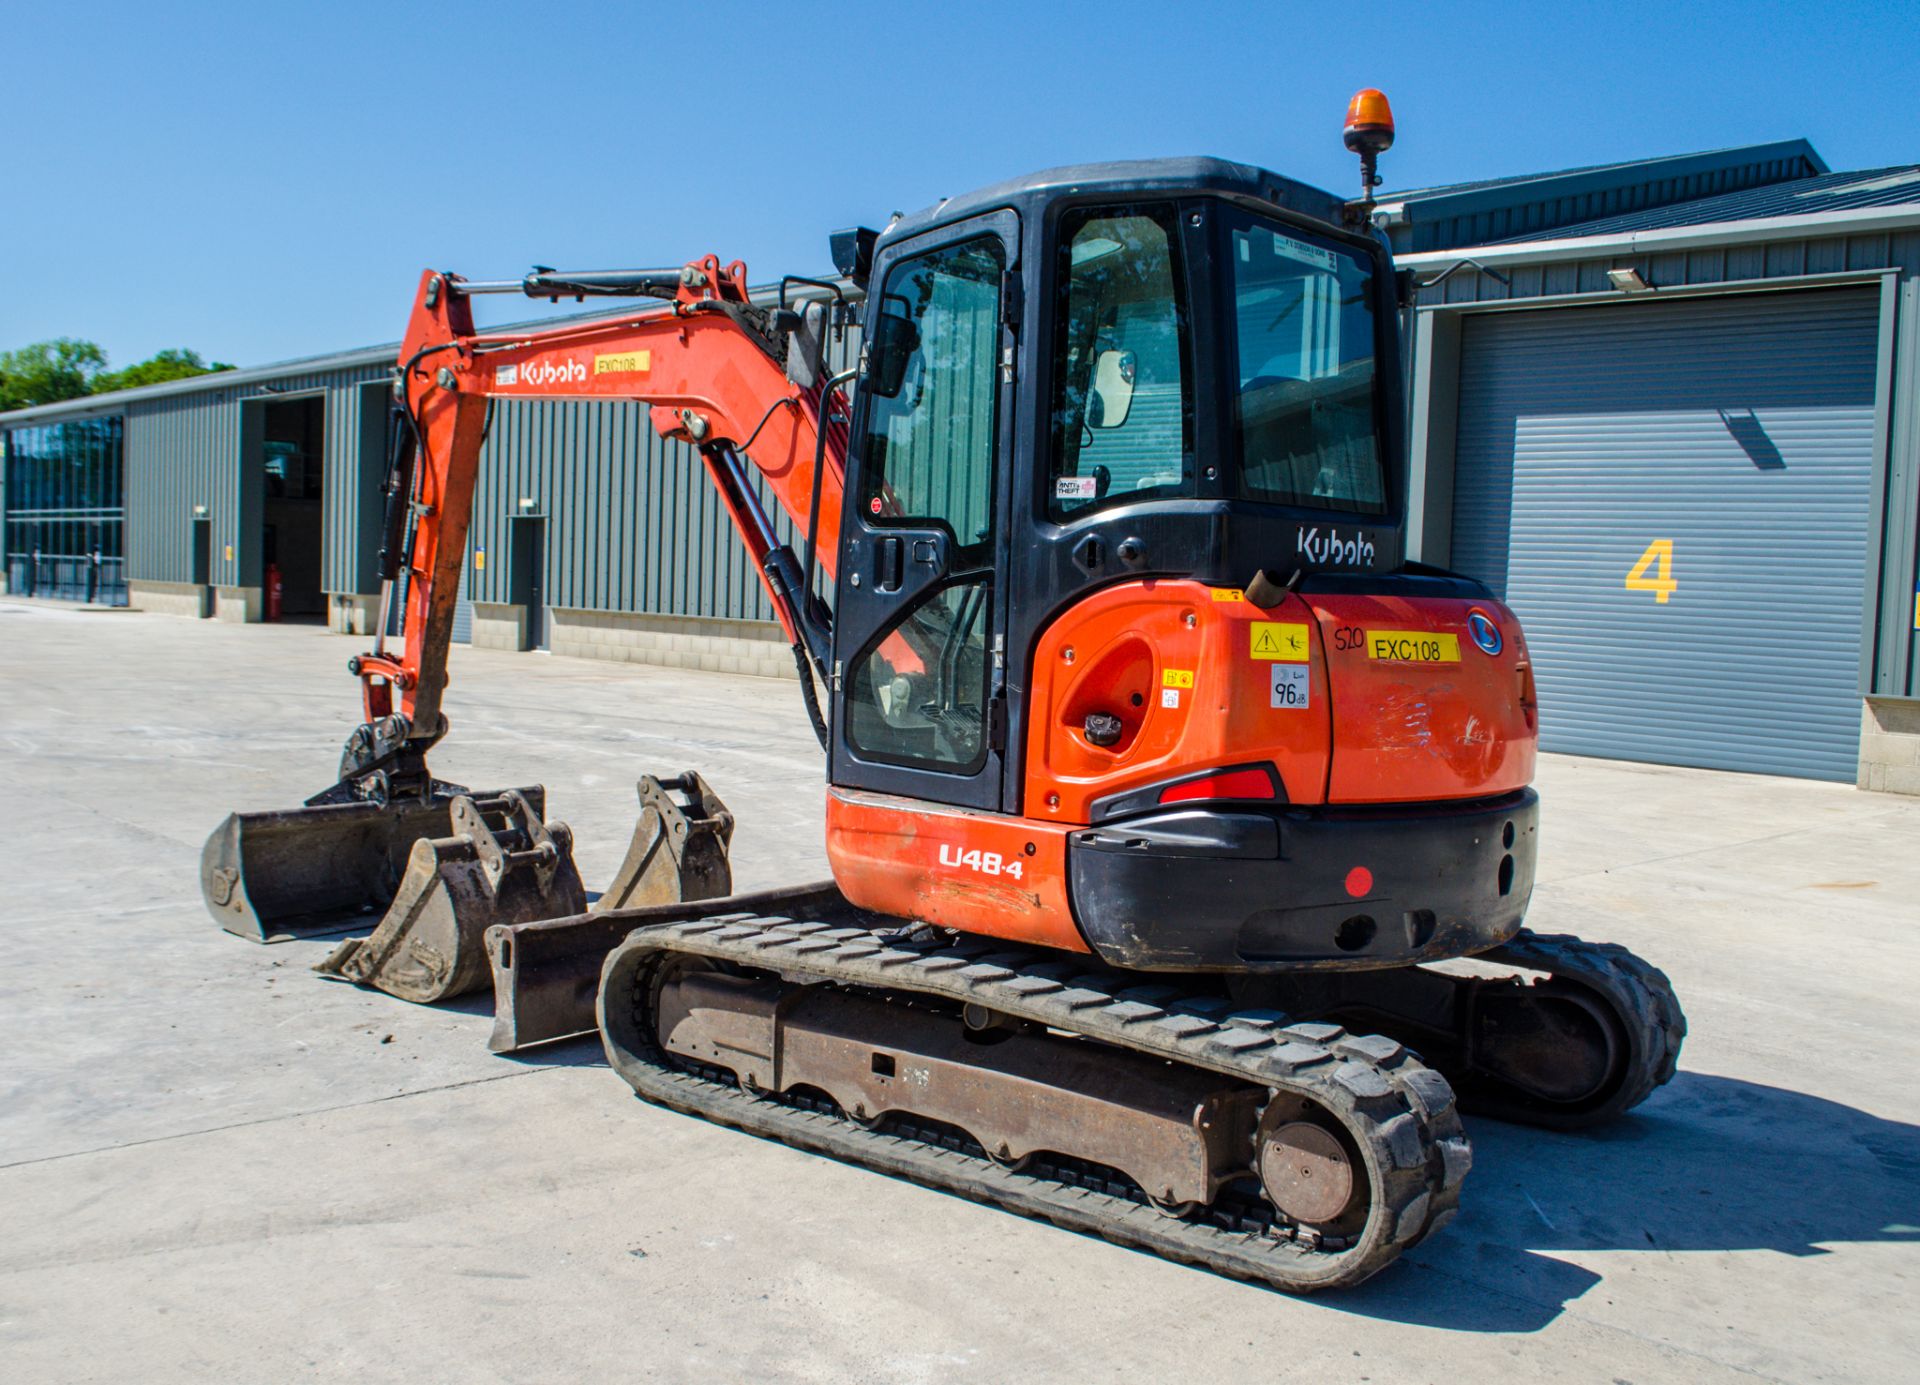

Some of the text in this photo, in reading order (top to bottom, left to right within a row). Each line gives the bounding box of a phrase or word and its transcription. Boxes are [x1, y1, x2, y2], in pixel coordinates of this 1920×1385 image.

[520, 357, 586, 385] Kubota
[599, 358, 635, 372] EXC108
[1297, 526, 1374, 567] Kubota
[1625, 539, 1678, 604] 4
[1335, 627, 1364, 650] S20
[1375, 640, 1440, 661] EXC108
[1275, 683, 1296, 704] 96
